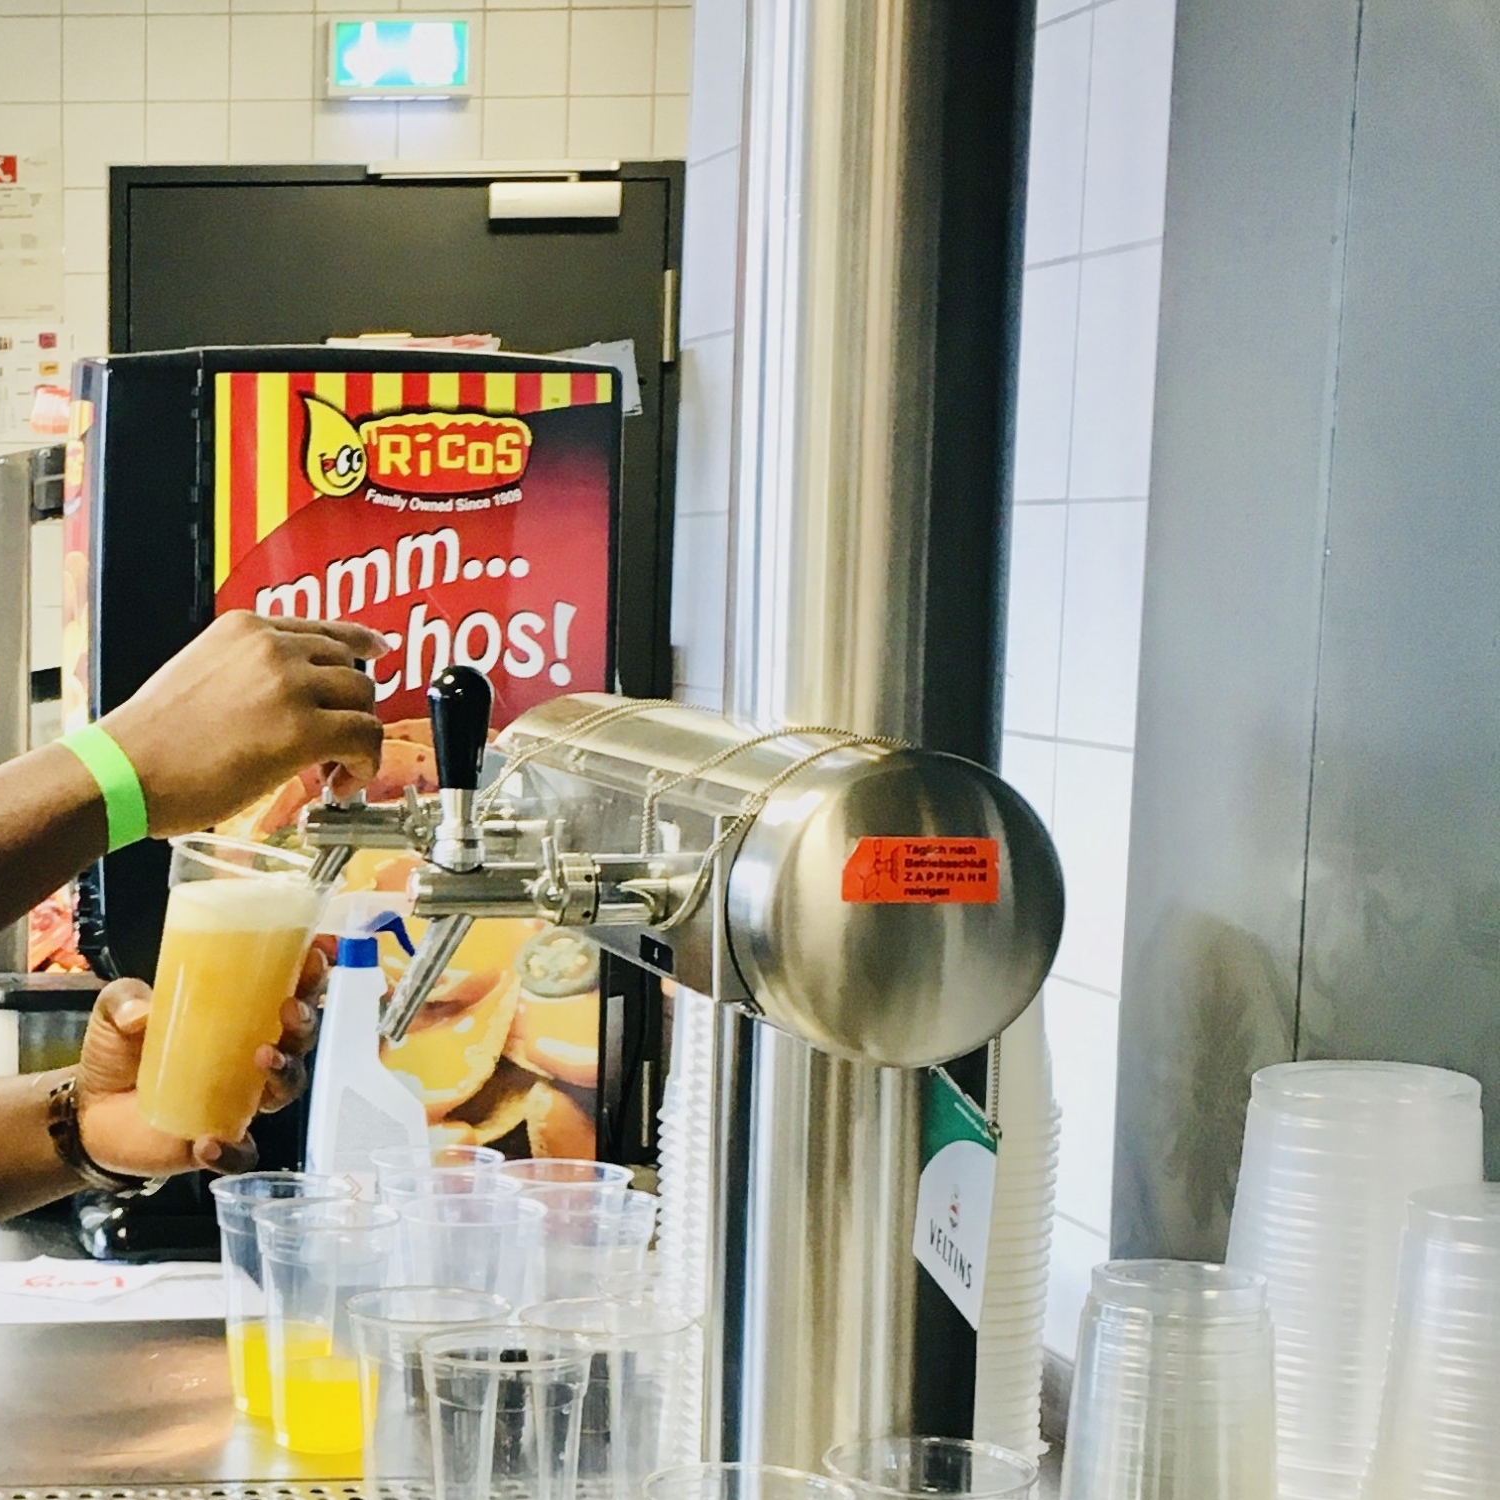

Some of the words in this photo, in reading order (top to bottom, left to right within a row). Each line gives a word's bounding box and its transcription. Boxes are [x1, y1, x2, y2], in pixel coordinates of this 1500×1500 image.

[365, 488, 408, 512] Family
[409, 497, 453, 512] Owned
[455, 497, 491, 511] Since
[492, 487, 523, 506] 1909
[365, 600, 578, 702] chos!
[949, 844, 977, 855] nach
[903, 871, 988, 882] ZAPFHAHN
[904, 885, 951, 898] reinigen
[929, 1218, 973, 1290] VELTINS
